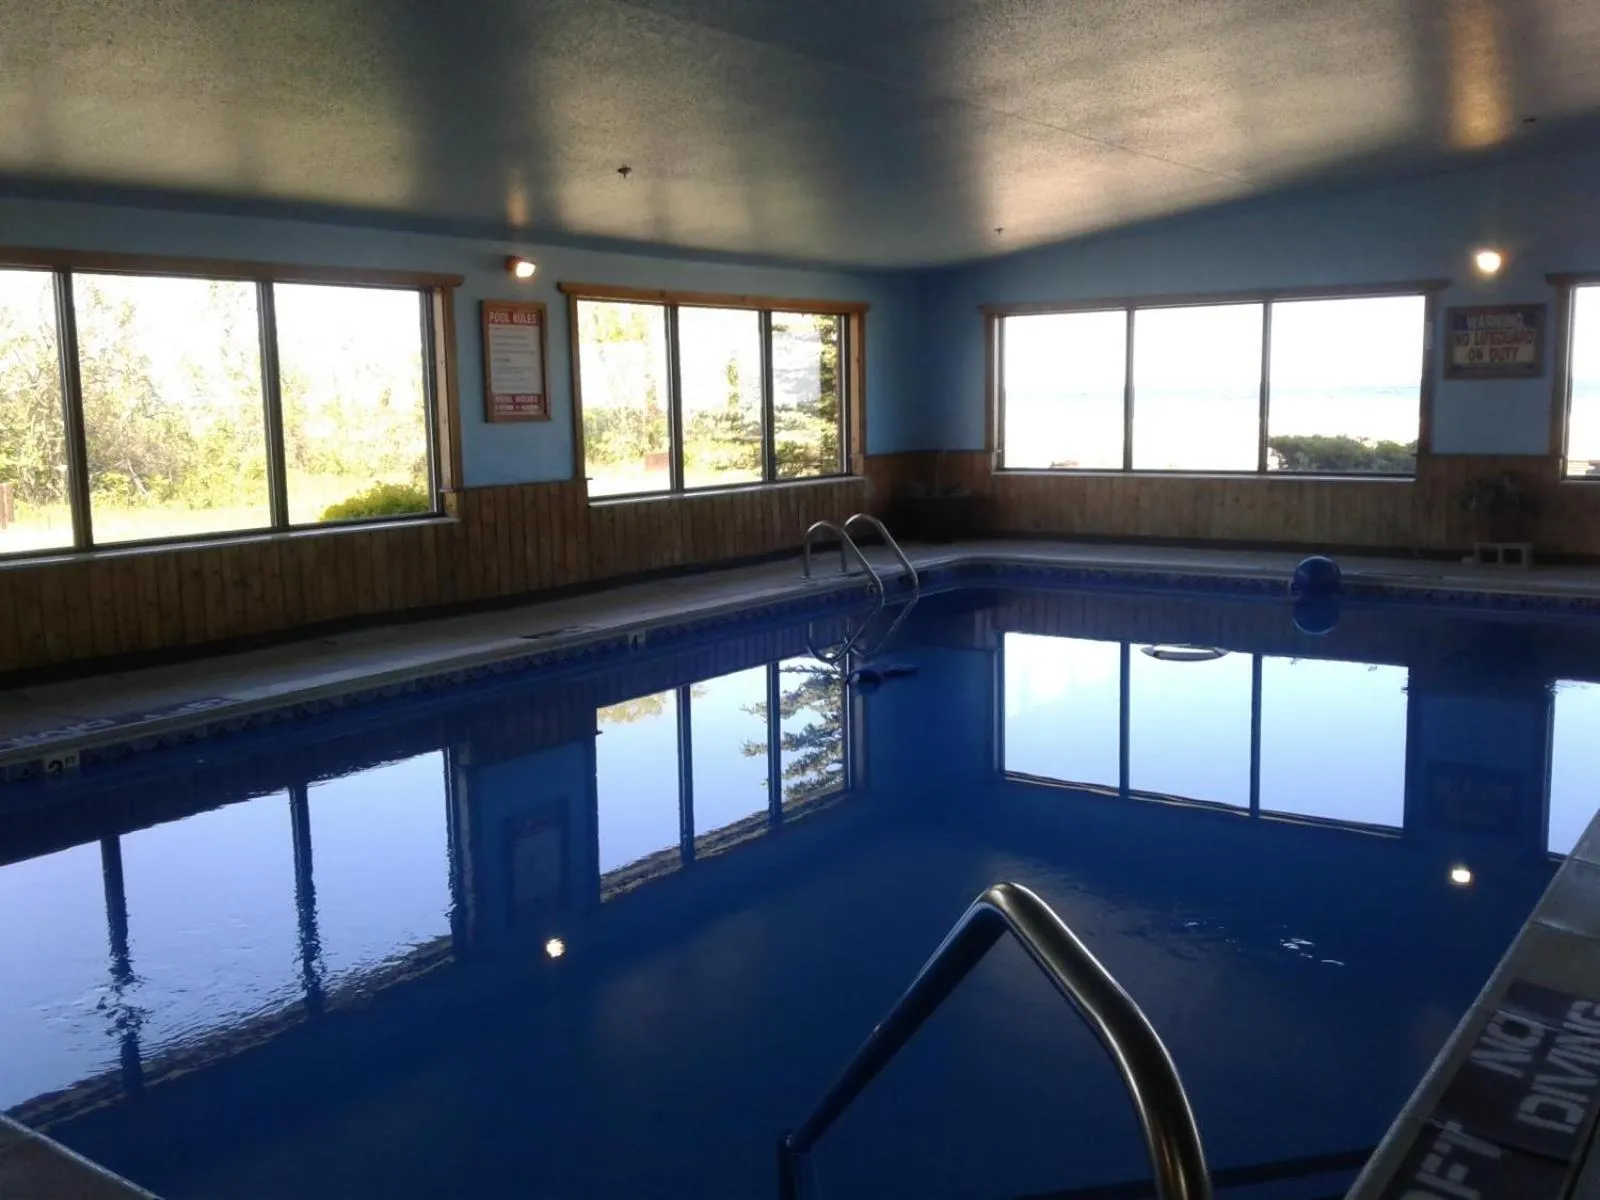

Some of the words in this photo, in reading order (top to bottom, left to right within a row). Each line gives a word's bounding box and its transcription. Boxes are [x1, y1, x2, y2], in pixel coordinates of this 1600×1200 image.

[489, 311, 511, 323] POOL
[513, 311, 537, 324] RULES
[1455, 333, 1469, 346] NO
[1468, 347, 1483, 361] ON
[1490, 346, 1519, 361] DUTY
[1469, 1009, 1546, 1079] NO
